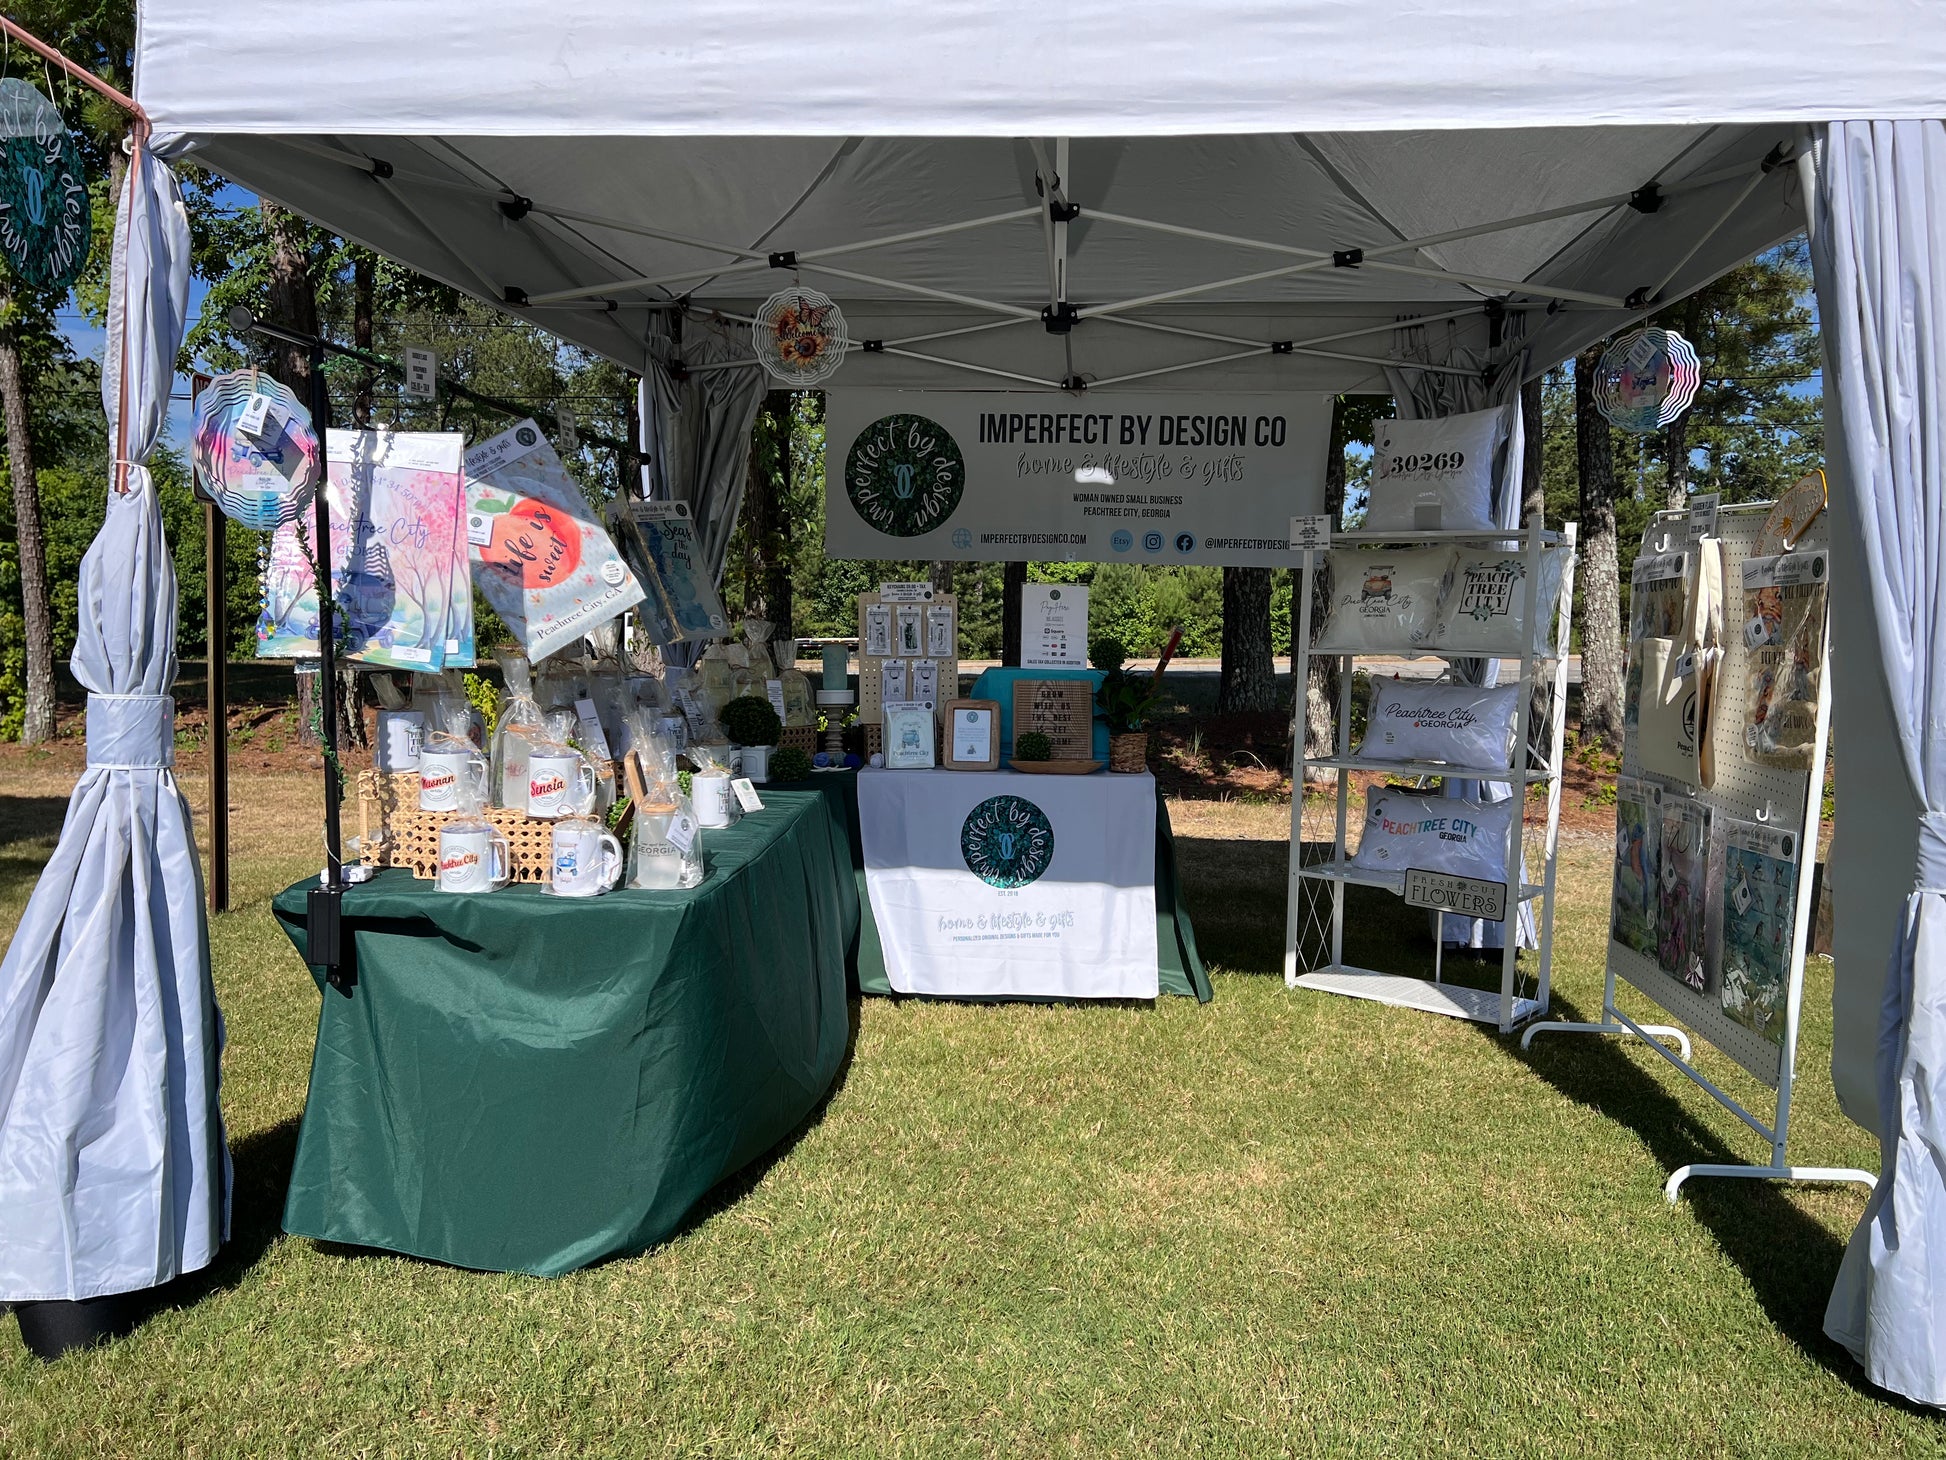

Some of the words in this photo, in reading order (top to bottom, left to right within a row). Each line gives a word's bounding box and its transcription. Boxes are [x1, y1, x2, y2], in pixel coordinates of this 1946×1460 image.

[35, 104, 63, 164] by
[50, 173, 84, 280] design
[908, 422, 936, 458] by
[979, 413, 1113, 444] IMPERFECT
[1119, 415, 1153, 445] BY
[1159, 415, 1247, 447] DESIGN
[1254, 416, 1287, 447] CO
[1017, 451, 1074, 478] home
[1079, 452, 1098, 477] &
[1102, 451, 1173, 483] lifestyle
[1179, 454, 1197, 479] &
[1202, 453, 1247, 487] gifts
[1391, 452, 1465, 474] 30269
[855, 421, 903, 529] imperfect
[915, 457, 957, 527] design
[1073, 493, 1099, 503] WOMAN
[1100, 494, 1125, 504] OWNED
[1126, 495, 1148, 504] SMALL
[1149, 495, 1183, 505] BUSINESS
[525, 507, 552, 531] is
[1083, 507, 1122, 517] PEACHTREE
[1123, 508, 1140, 519] CITY,
[1142, 508, 1171, 518] GEORGIA
[303, 511, 388, 545] Pachtree
[390, 516, 432, 549] City
[660, 520, 692, 541] Seas
[980, 533, 1087, 545] IMPERFECTBYDESIGNCO.COM
[1113, 536, 1131, 546] Etsy
[1205, 537, 1290, 551] @IMPERFECTBYDESIG
[539, 531, 568, 583] sweet
[671, 545, 692, 570] day
[1470, 572, 1511, 583] PEACH
[1468, 583, 1508, 595] TREE
[1465, 596, 1505, 608] CITY
[537, 611, 584, 639] Peachtree
[605, 587, 623, 600] GA
[1061, 702, 1071, 710] US
[1385, 702, 1447, 718] Peachtree
[1420, 720, 1463, 729] GEORGIA
[530, 778, 564, 796] Senoia
[1009, 801, 1031, 828] by
[1382, 818, 1448, 835] PEACHTREE
[1452, 819, 1478, 838] CITY
[1439, 832, 1467, 843] GEORGIA
[969, 801, 1005, 880] imperfect
[463, 854, 478, 865] City
[1016, 827, 1047, 882] design
[1413, 875, 1453, 889] FRESH
[1470, 885, 1497, 896] CUT
[1411, 885, 1497, 915] FLOWERS
[937, 914, 974, 932] home
[977, 913, 988, 930] &
[991, 911, 1033, 931] lifestyle
[1036, 911, 1047, 927] &
[1049, 910, 1075, 931] gifts
